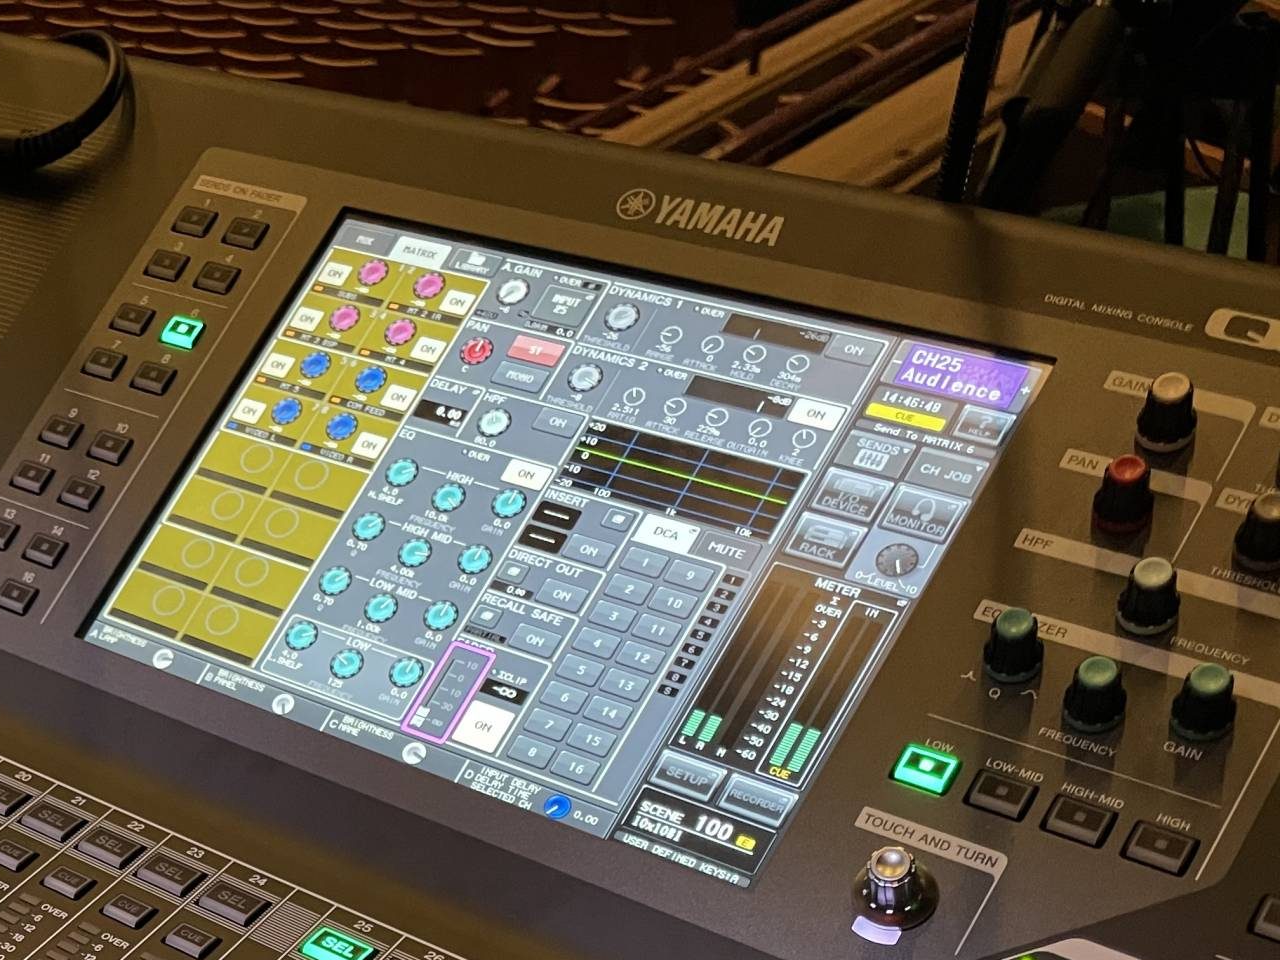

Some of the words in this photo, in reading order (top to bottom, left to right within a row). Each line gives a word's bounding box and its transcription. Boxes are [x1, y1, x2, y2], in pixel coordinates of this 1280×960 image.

[654, 195, 785, 247] YAMAHA
[403, 245, 440, 262] MATRIX
[609, 285, 672, 309] DYNAMICS
[1044, 293, 1086, 311] DIGITAL
[1091, 304, 1133, 320] MIXING
[1137, 313, 1194, 332] CONSOLE
[466, 320, 488, 334] PAN
[572, 346, 635, 369] DYNAMICS
[844, 343, 865, 356] ON
[913, 350, 963, 373] CH25
[430, 378, 467, 396] DELAY
[900, 366, 1001, 401] Audience
[484, 393, 506, 405] HPF
[399, 429, 415, 441] EQ
[874, 423, 900, 436] Send
[906, 430, 918, 440] To
[922, 434, 963, 451] MATRIX
[857, 437, 900, 456] SENDS
[1067, 455, 1099, 470] PAN
[446, 470, 475, 486] HIGH
[920, 463, 942, 477] CH
[944, 468, 973, 484] JOB
[544, 489, 589, 508] INSERT
[821, 496, 869, 515] DEVICE
[401, 522, 430, 538] HIGH
[431, 530, 454, 544] MID
[654, 527, 679, 541] DCA
[887, 513, 946, 536] MONITOR
[707, 540, 747, 561] MUTE
[799, 542, 835, 560] RACK
[1022, 534, 1054, 550] HPF
[508, 550, 551, 569] DIRECT
[556, 562, 584, 578] OUT
[369, 578, 393, 591] LOW
[396, 586, 418, 600] MID
[815, 577, 861, 598] METER
[481, 592, 528, 613] RECALL
[531, 609, 564, 626] SAFE
[815, 604, 843, 618] OVER
[346, 637, 372, 651] LOW
[1170, 636, 1250, 667] FREQUENCY
[925, 738, 955, 752] LOW
[1038, 727, 1118, 758] FREQUENCY
[1163, 741, 1203, 762] GAIN
[666, 765, 709, 787] SETUP
[769, 767, 791, 779] CUE
[985, 758, 1045, 783] LOW-MID
[730, 789, 784, 813] RECORDER
[1061, 782, 1125, 809] HIGH-MID
[640, 800, 685, 824] SCENE
[695, 814, 733, 840] 100
[1156, 812, 1192, 832] HIGH
[623, 833, 648, 850] USER
[651, 844, 697, 869] DEFINED
[863, 812, 916, 840] TOUCH
[918, 832, 951, 851] AND
[956, 843, 1000, 869] TURN
[354, 920, 373, 933] 25
[321, 936, 355, 958] SEL
